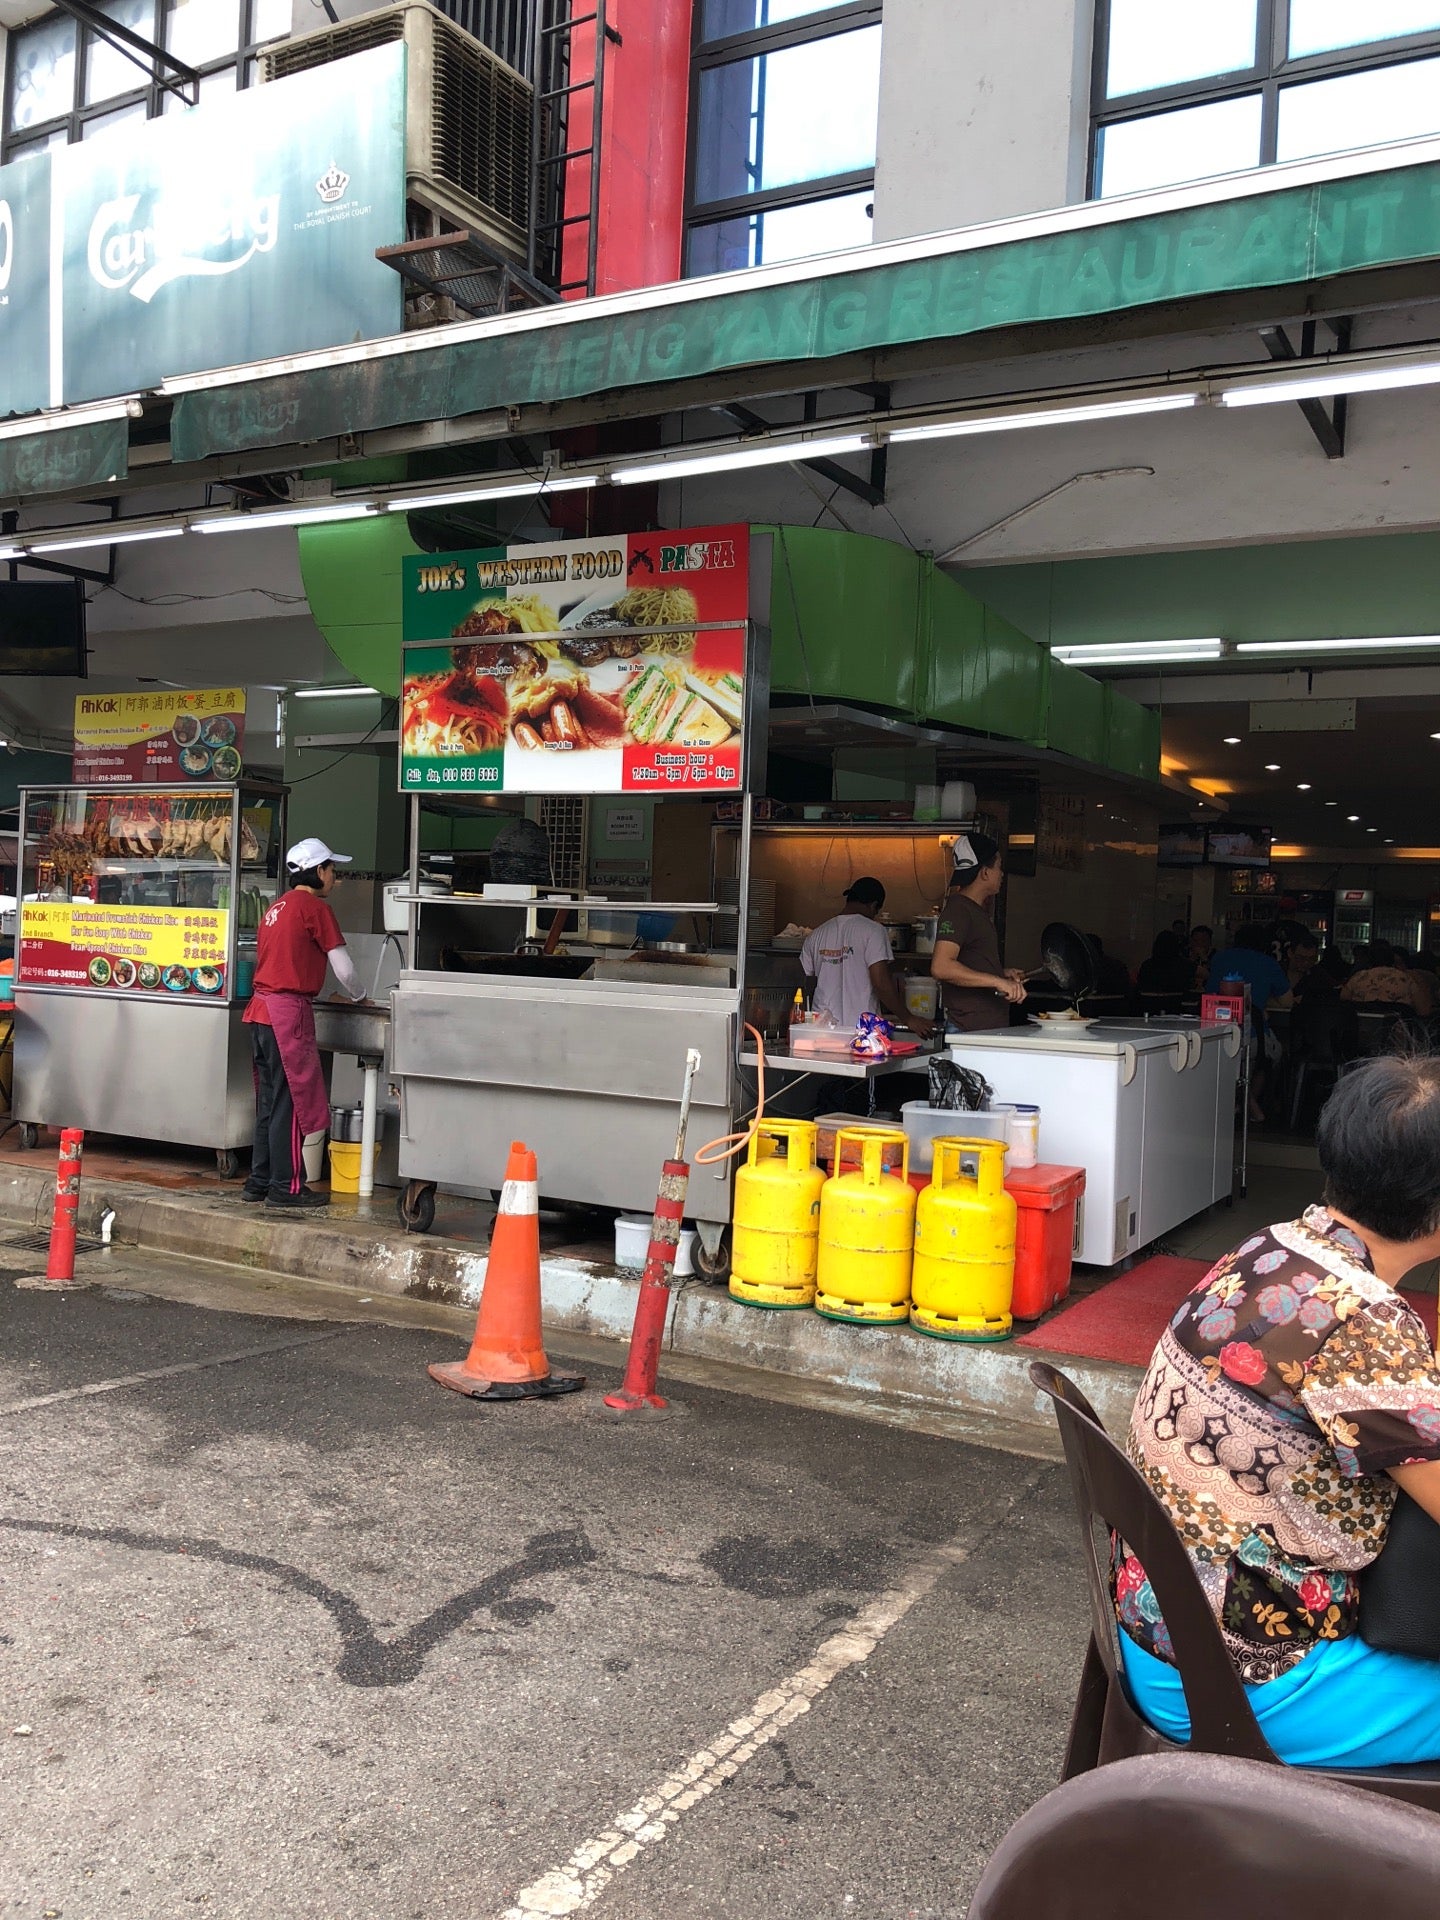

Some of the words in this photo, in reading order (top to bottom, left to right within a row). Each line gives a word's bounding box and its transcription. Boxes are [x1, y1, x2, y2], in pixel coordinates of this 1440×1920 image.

[294, 222, 306, 231] THE
[306, 217, 326, 227] ROYAL
[327, 211, 350, 223] DANISH
[351, 205, 372, 217] COURT
[882, 192, 1403, 338] RESTAURANT
[417, 560, 467, 594] JOE's
[477, 554, 568, 589] WESTERN
[571, 550, 624, 579] FOOD
[660, 540, 735, 573] PASTA
[655, 752, 687, 766] Business
[688, 752, 707, 765] hour
[478, 767, 498, 781] 5026
[632, 767, 659, 780] 7.30am
[691, 766, 707, 782] 5pm
[715, 766, 735, 782] 10pm
[139, 913, 163, 925] Chicken
[110, 927, 127, 939] With
[128, 928, 152, 940] Chicken
